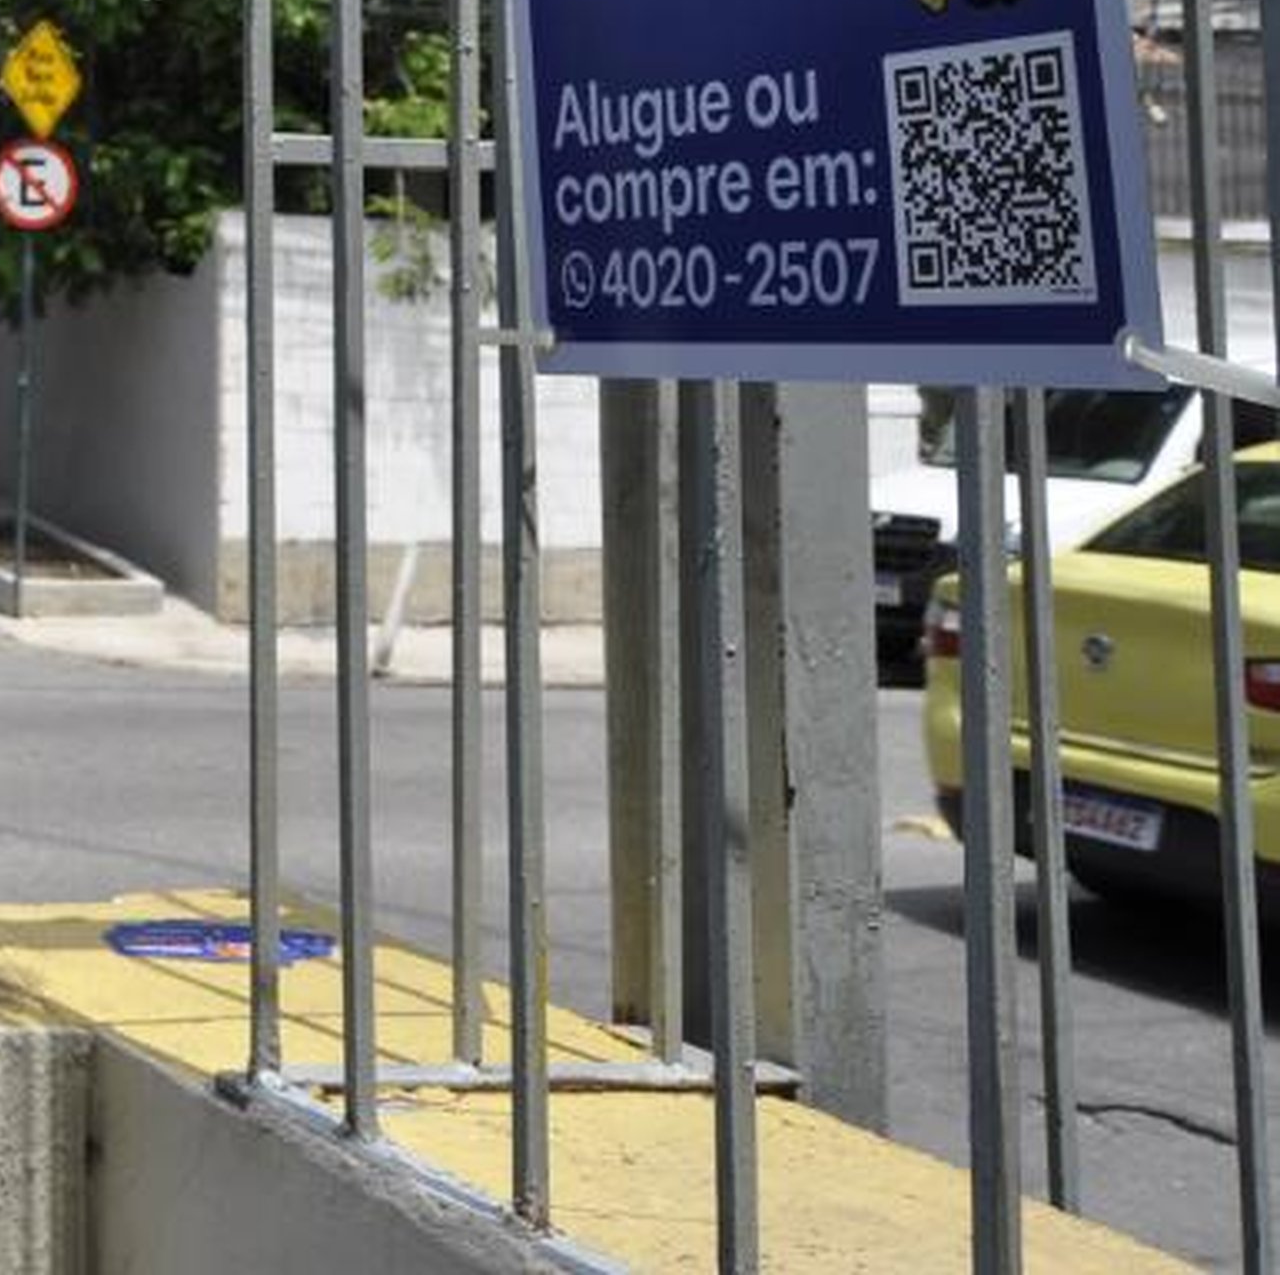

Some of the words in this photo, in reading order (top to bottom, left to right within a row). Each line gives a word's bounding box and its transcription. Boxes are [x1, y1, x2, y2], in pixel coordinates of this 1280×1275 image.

[554, 78, 732, 158] Alugue
[745, 69, 819, 129] ou
[555, 161, 752, 235] compre
[765, 149, 878, 211] em:
[601, 237, 880, 309] 4020-2507
